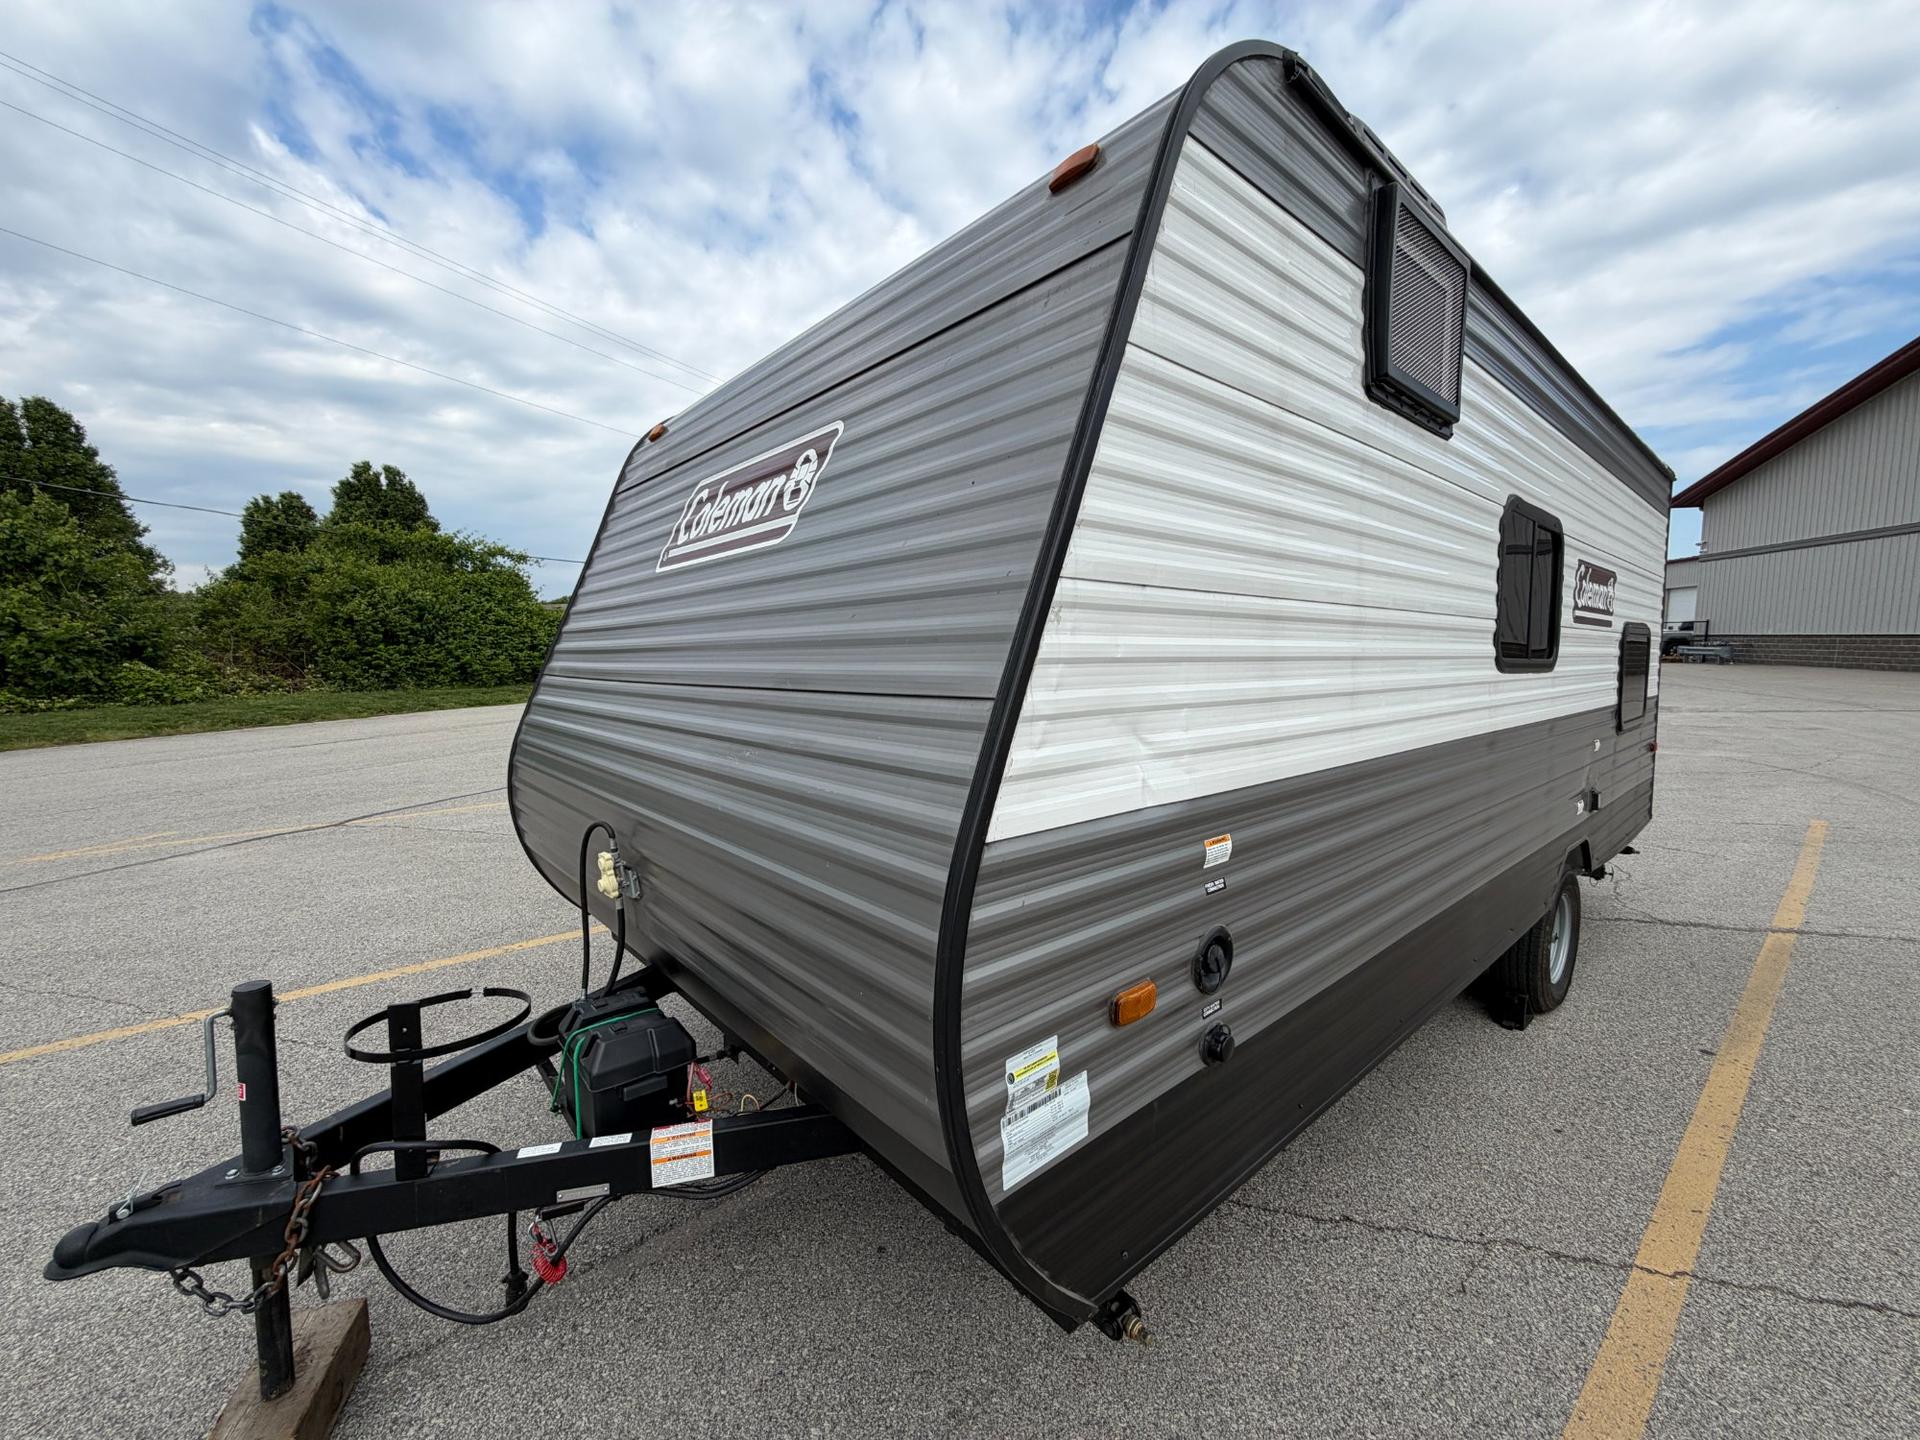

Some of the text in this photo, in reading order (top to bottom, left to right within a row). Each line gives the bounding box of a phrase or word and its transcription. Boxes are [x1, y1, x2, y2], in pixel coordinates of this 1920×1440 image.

[677, 474, 788, 545] Coleman
[1575, 564, 1608, 610] Coleman
[672, 1152, 697, 1161] WARNING
